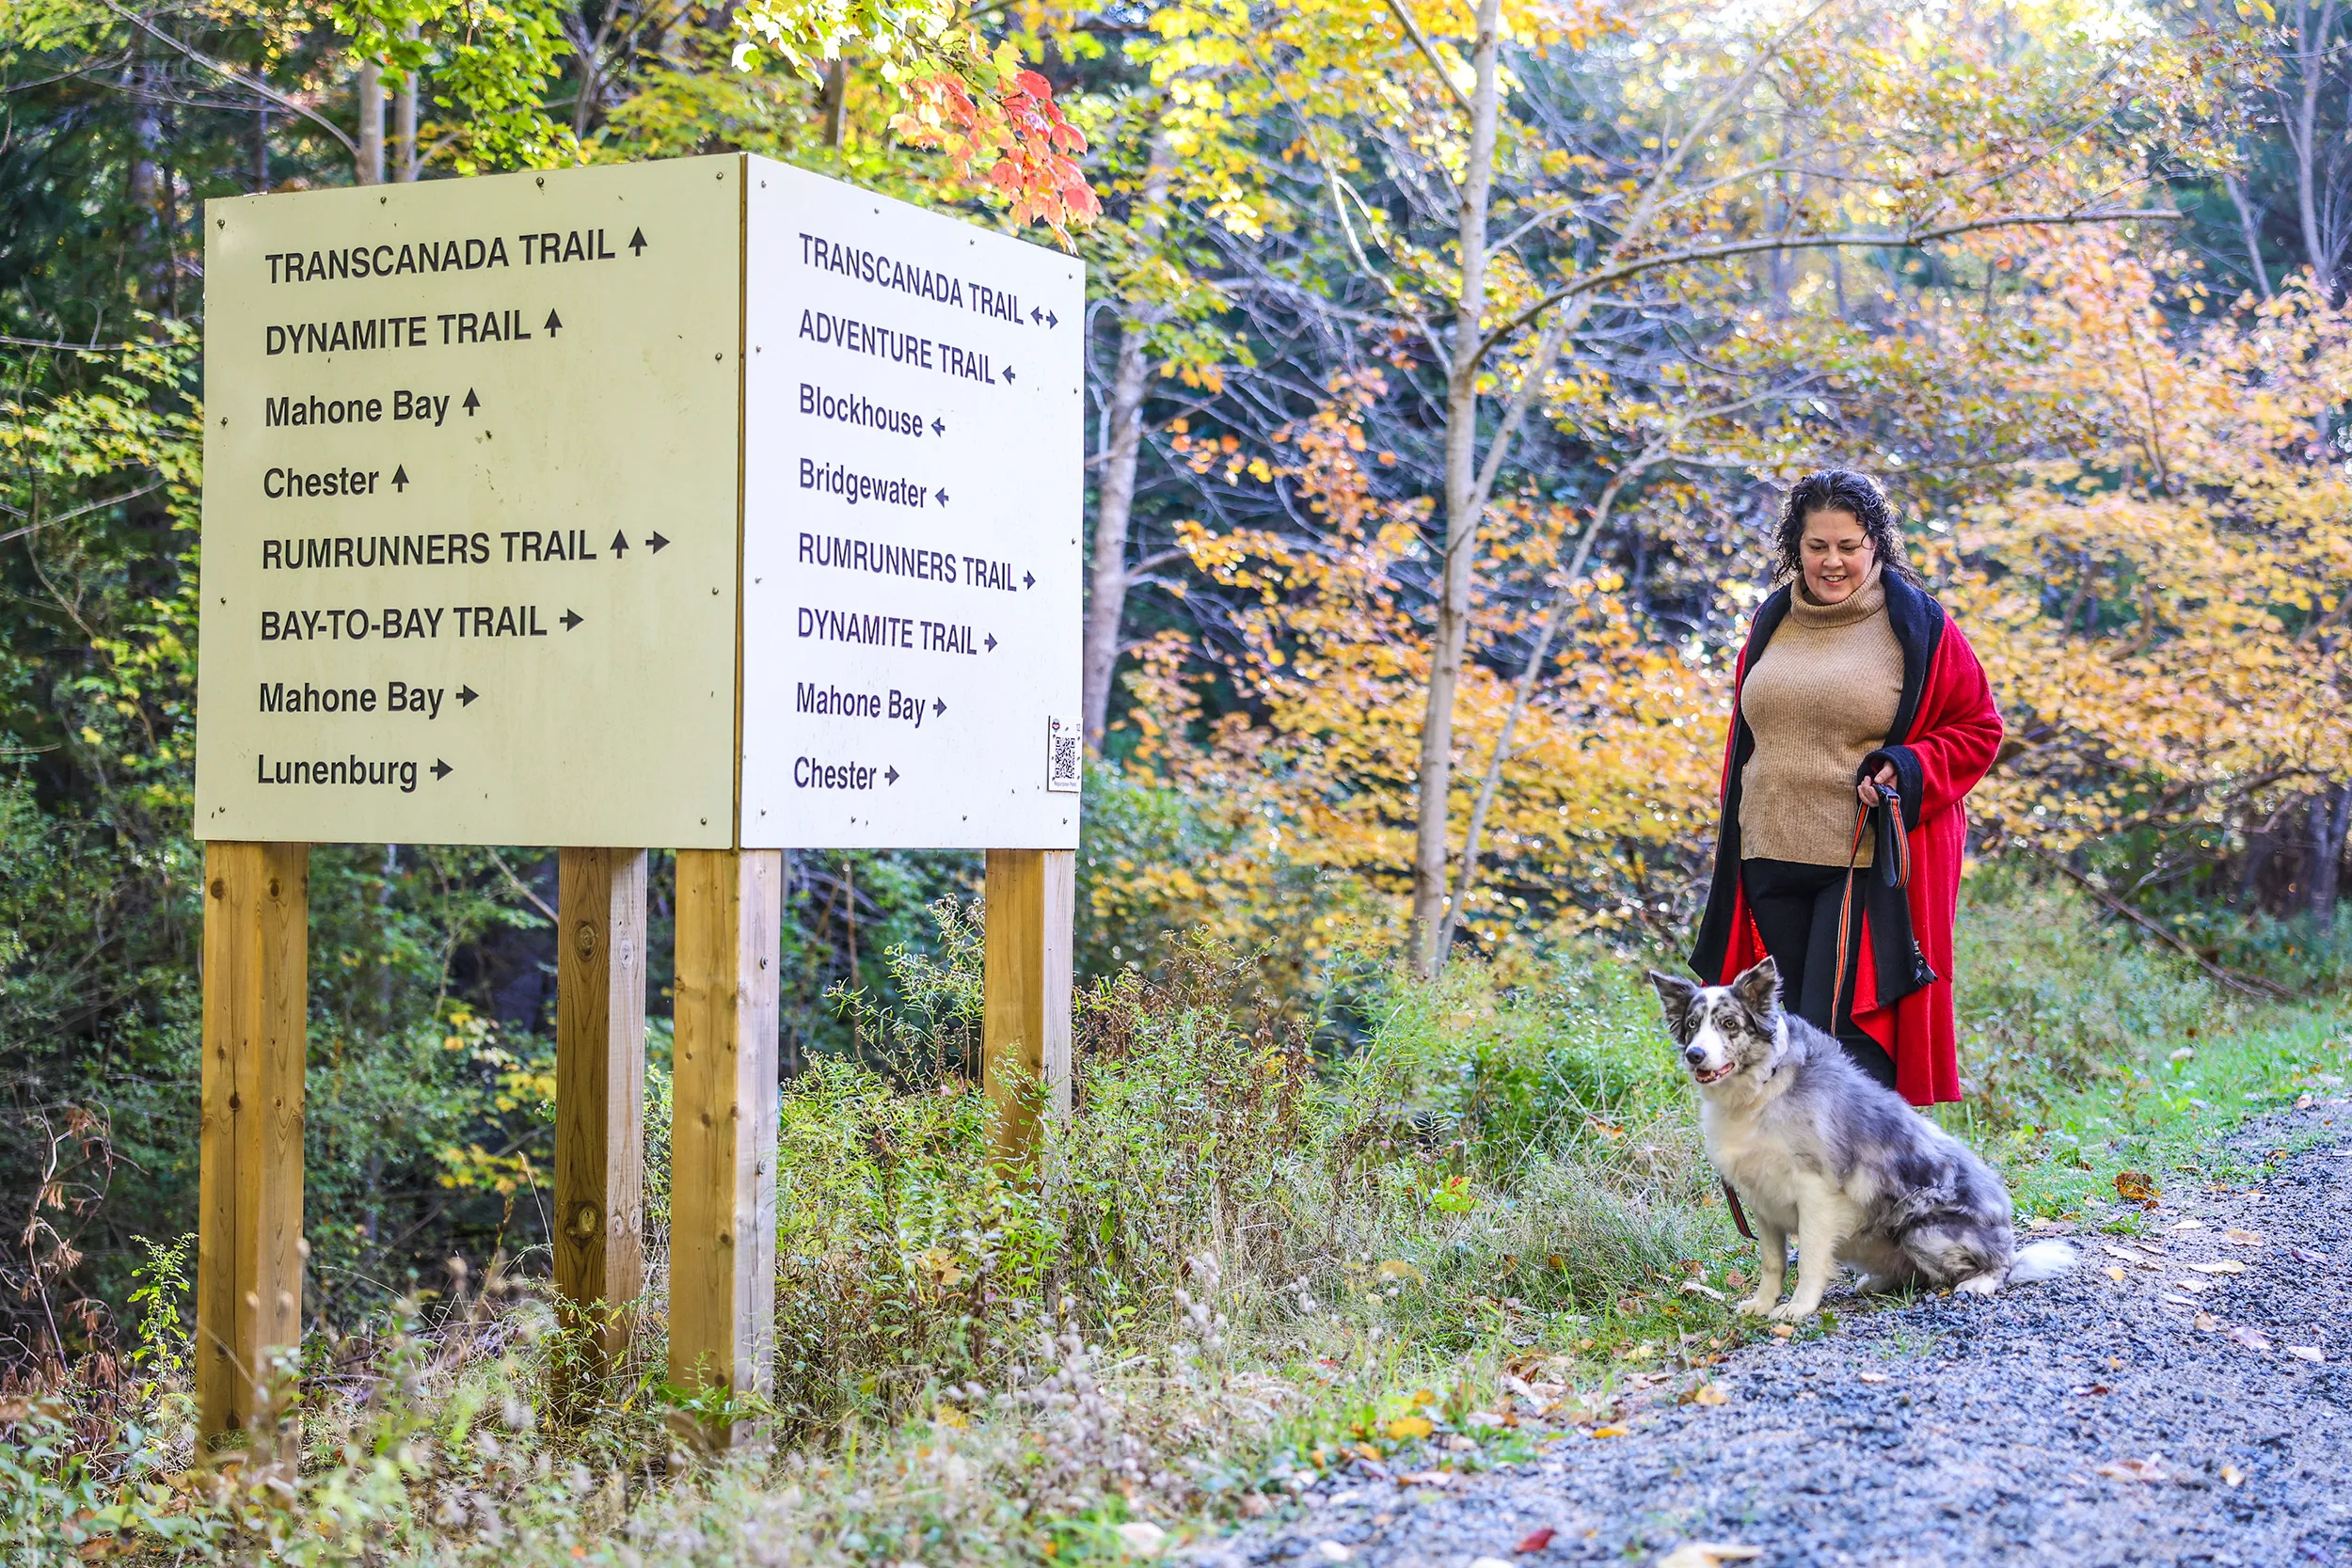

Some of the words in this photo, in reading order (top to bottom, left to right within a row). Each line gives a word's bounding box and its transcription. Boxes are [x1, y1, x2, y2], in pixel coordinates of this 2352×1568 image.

[264, 236, 510, 284] TRANSCANADA
[518, 228, 616, 265] TRAIL
[799, 232, 963, 309] TRANSCANADA
[968, 282, 1025, 325] TRAIL
[266, 315, 427, 356] DYNAMITE
[437, 309, 532, 345] TRAIL
[799, 309, 932, 370] ADVENTURE
[938, 342, 995, 385] TRAIL
[265, 394, 383, 427] Mahone
[393, 389, 451, 428] Bay
[800, 383, 923, 437] Blockhouse
[263, 467, 380, 499] Chester
[800, 457, 927, 508] Bridgewater
[262, 531, 490, 570] RUMRUNNERS
[500, 529, 597, 562] TRAIL
[799, 531, 957, 584] RUMRUNNERS
[962, 556, 1017, 593] TRAIL
[261, 607, 445, 641] BAY-TO-BAY
[453, 605, 548, 638] TRAIL
[798, 607, 914, 649] DYNAMITE
[920, 620, 977, 656] TRAIL
[259, 682, 377, 713] Mahone
[388, 681, 445, 721] Bay
[796, 682, 882, 719] Mahone
[888, 689, 926, 729] Bay
[257, 753, 418, 794] Lunenburg
[794, 756, 877, 790] Chester
